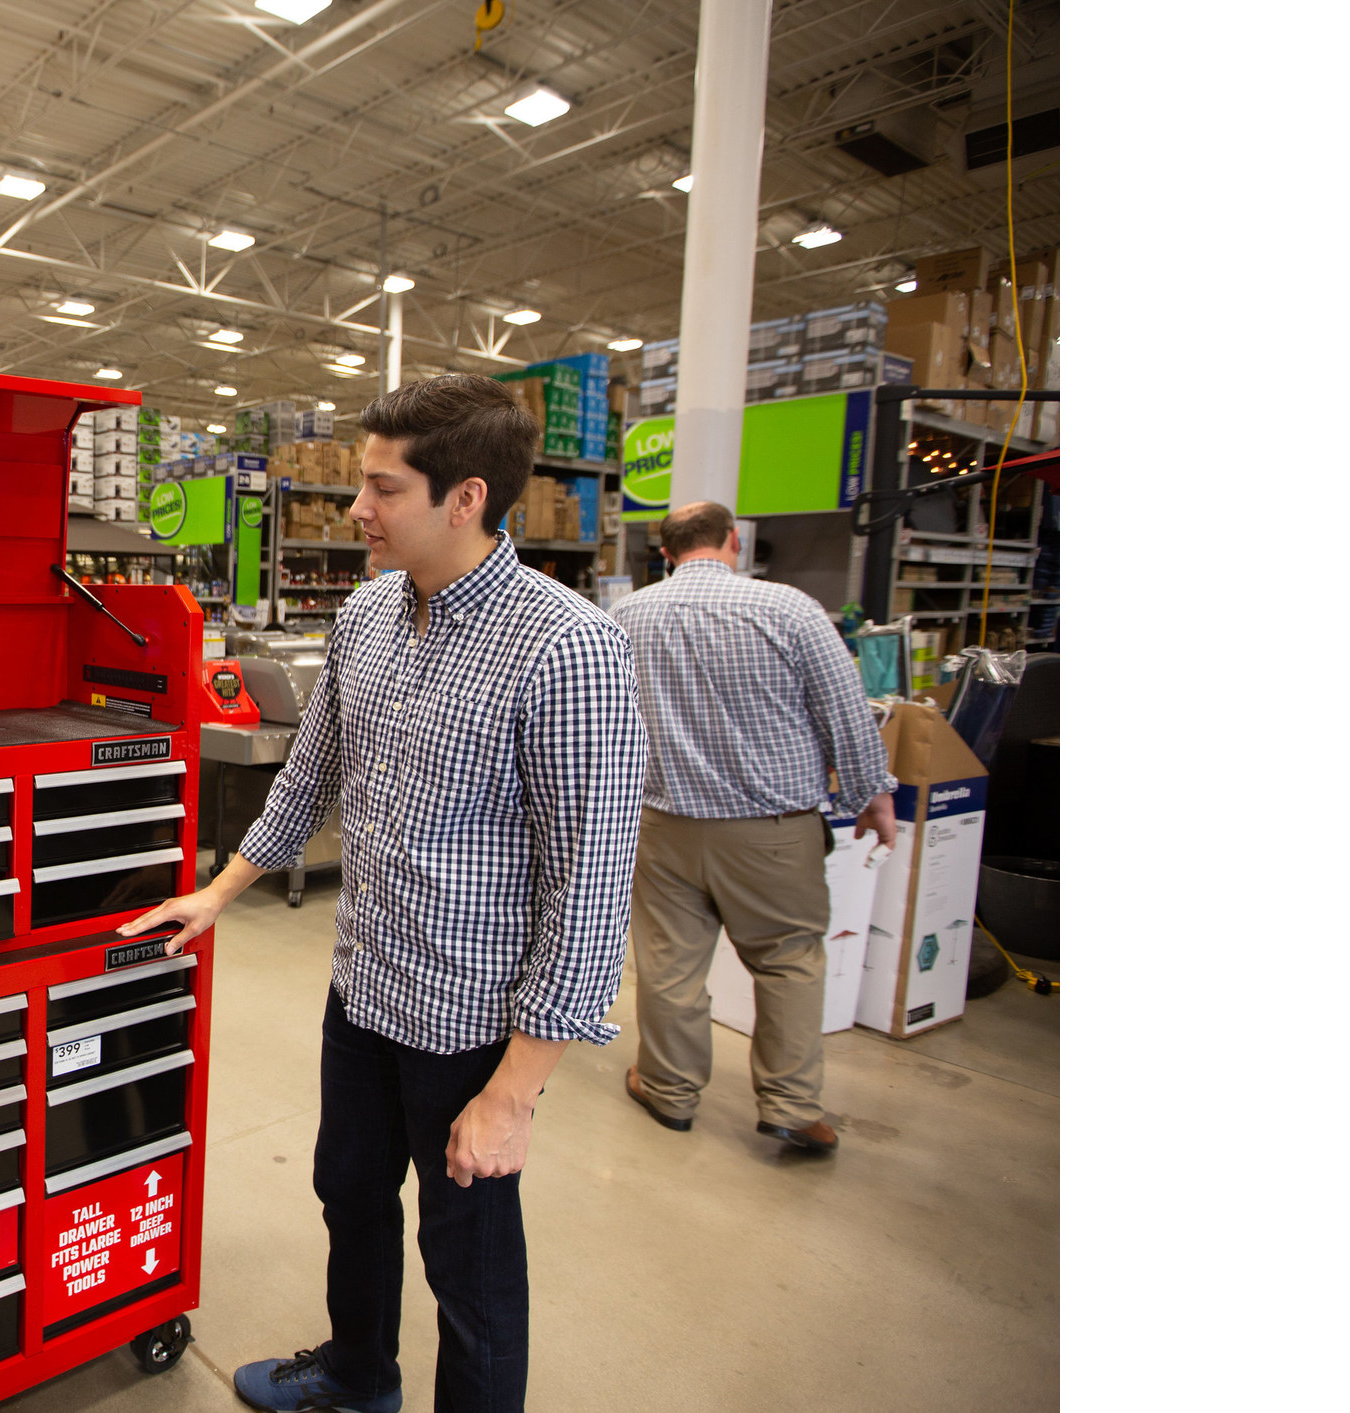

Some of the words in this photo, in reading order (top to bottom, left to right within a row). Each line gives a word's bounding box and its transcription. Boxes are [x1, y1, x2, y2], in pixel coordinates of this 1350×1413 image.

[624, 449, 673, 477] PRIC
[156, 490, 174, 506] LOW
[98, 742, 167, 760] CRAFTSMAN
[111, 942, 164, 965] CRAFTSM
[55, 1042, 81, 1058] $399
[72, 1202, 103, 1224] TALL
[130, 1205, 143, 1222] 12
[145, 1193, 174, 1217] INCH
[59, 1214, 115, 1248] DRAWER
[130, 1221, 172, 1248] DRAWER
[139, 1213, 164, 1232] DEEP
[51, 1245, 80, 1268] FITS
[82, 1228, 121, 1256] LARGE
[63, 1250, 110, 1281] POWER
[66, 1269, 106, 1297] TOOLS
